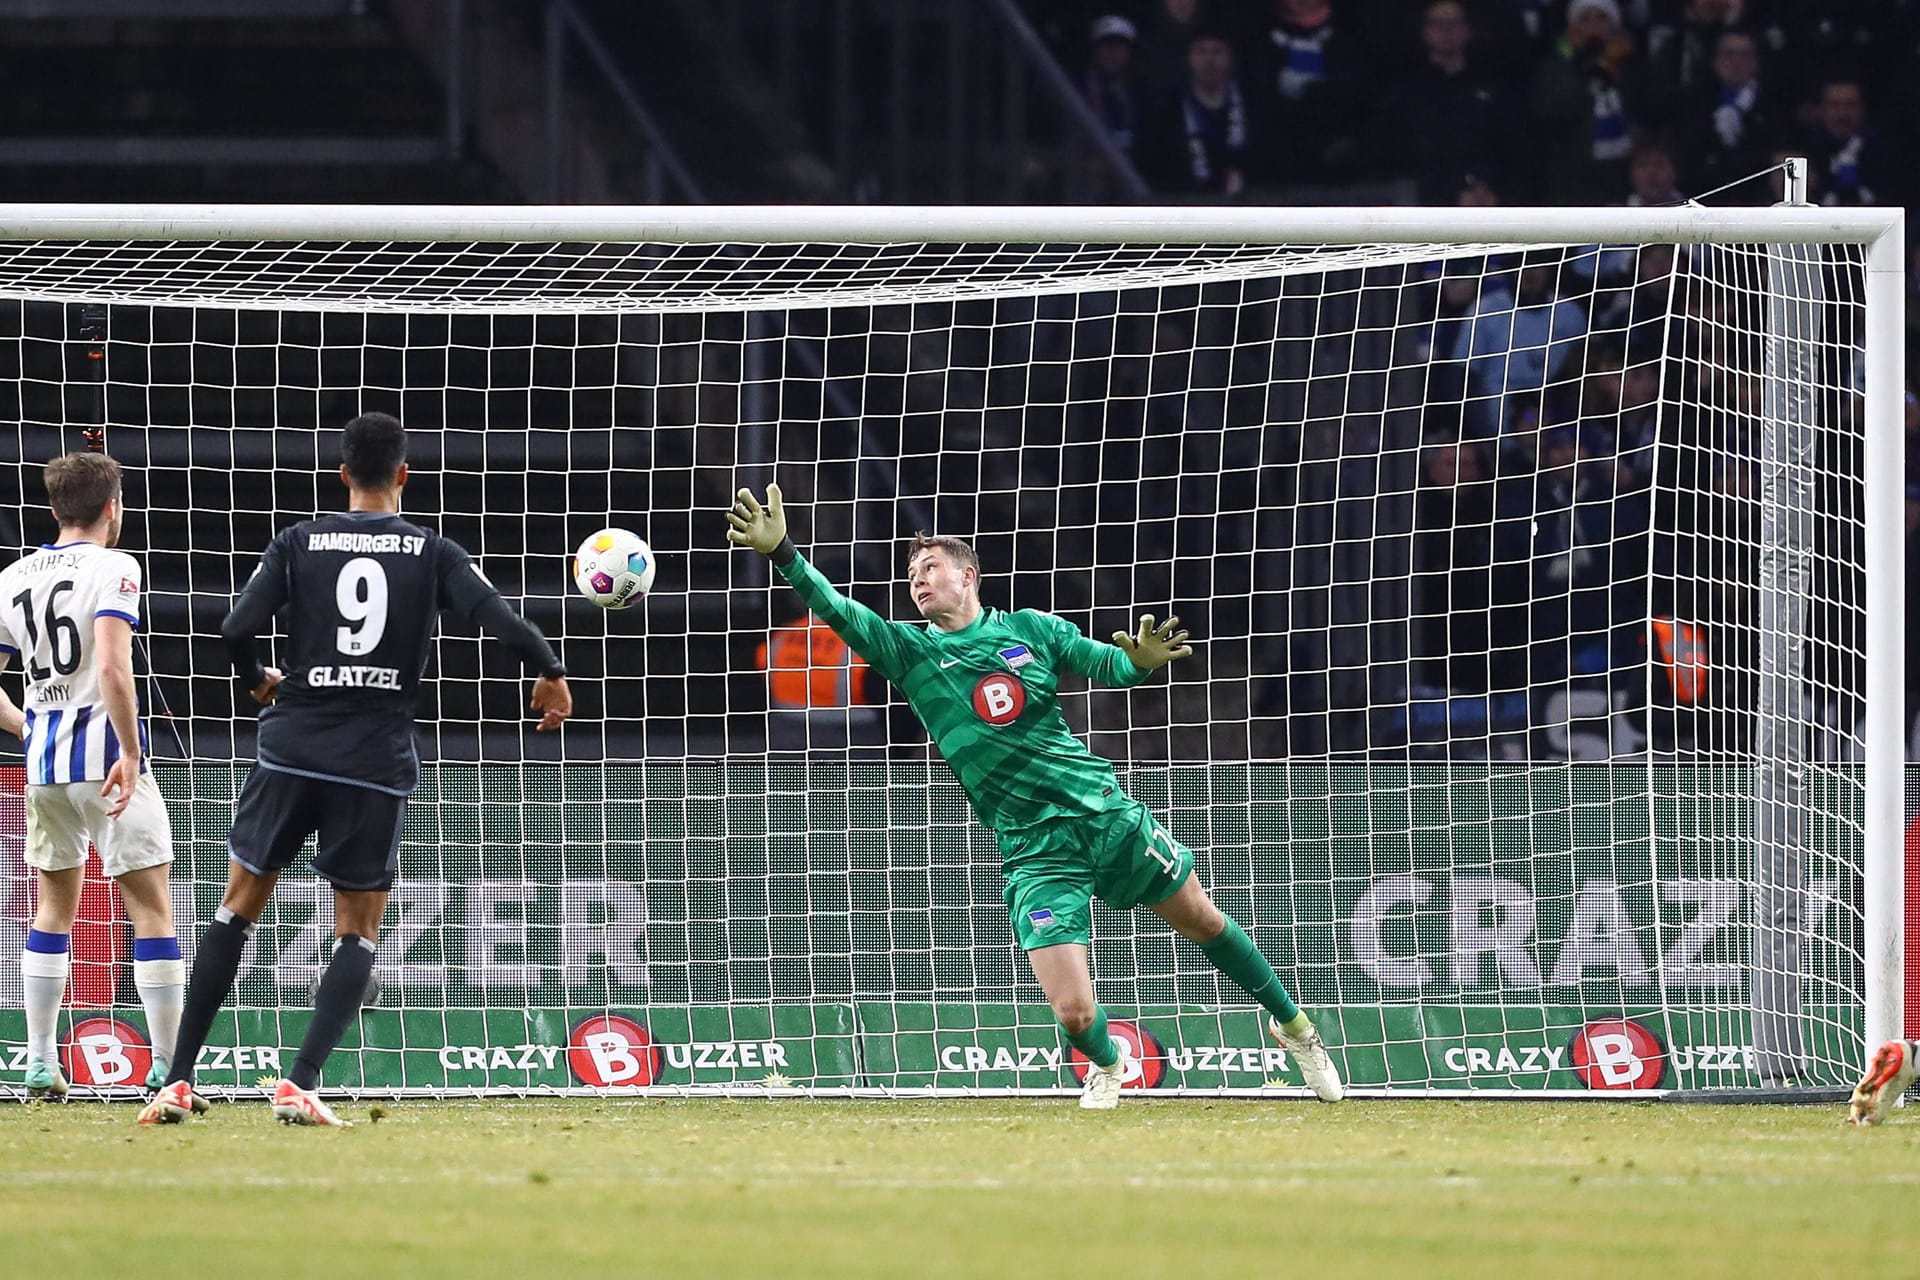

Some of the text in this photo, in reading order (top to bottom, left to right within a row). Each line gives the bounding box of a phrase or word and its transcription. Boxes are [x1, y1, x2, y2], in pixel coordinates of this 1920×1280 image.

[308, 532, 426, 556] HAMBURGER SV
[13, 580, 82, 681] 16
[336, 557, 388, 656] 9
[37, 684, 70, 703] ENNY
[308, 665, 402, 690] GLATZEL
[983, 683, 1014, 717] B
[1349, 874, 1840, 986] CRAZ
[79, 1034, 132, 1085] B
[438, 1045, 559, 1070] CRAZY
[584, 1032, 640, 1083] B
[941, 1046, 1062, 1071] CRAZY
[1444, 1046, 1565, 1072] CRAZY
[1589, 1033, 1644, 1086] B
